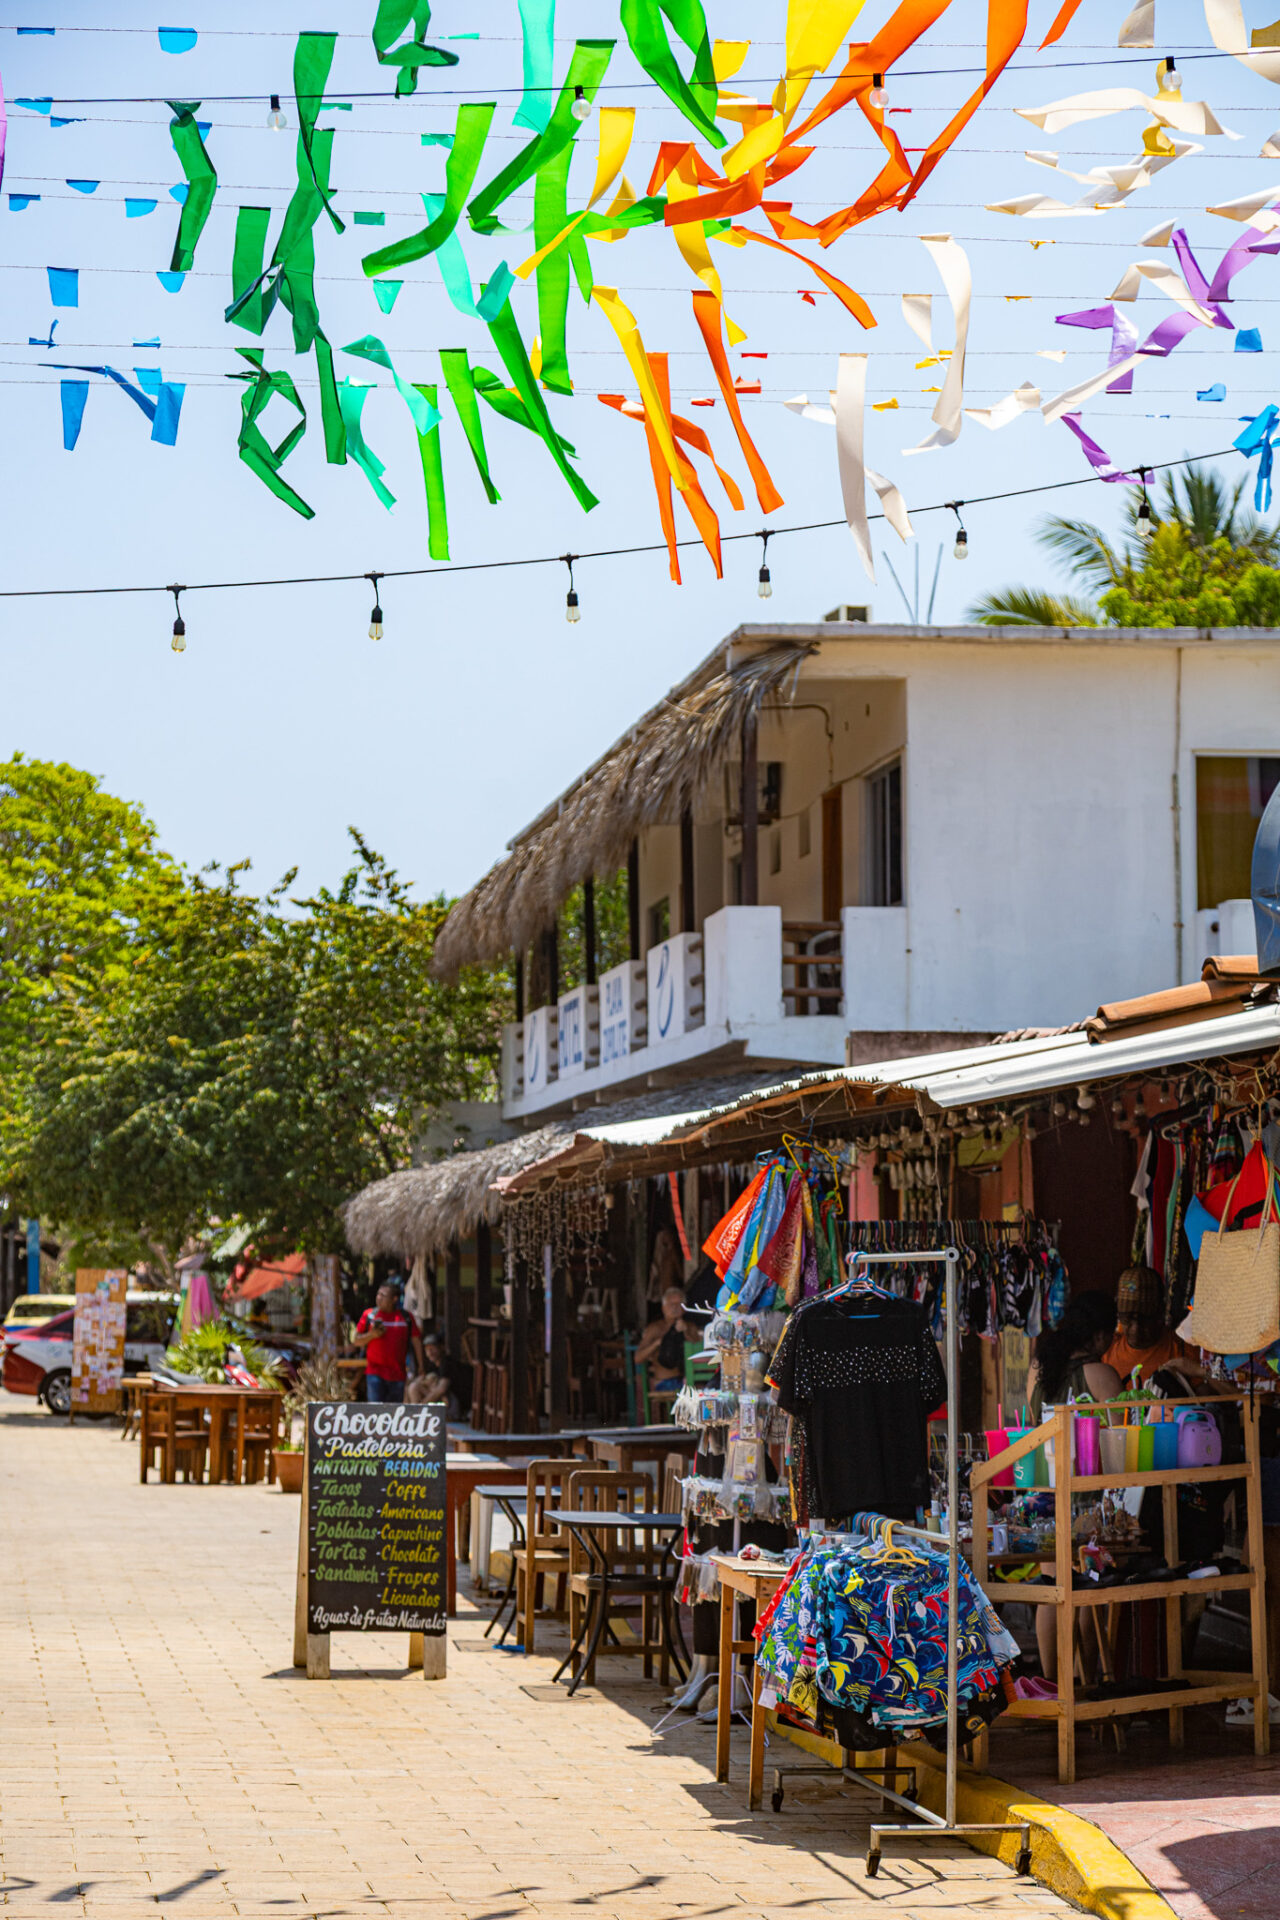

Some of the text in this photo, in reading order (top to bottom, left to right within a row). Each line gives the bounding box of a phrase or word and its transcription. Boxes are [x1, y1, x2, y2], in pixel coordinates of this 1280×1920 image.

[314, 1404, 440, 1437] Chocolate
[325, 1437, 427, 1458] Pasteleria
[386, 1480, 427, 1501] Coffe
[387, 1566, 440, 1589] Frapes
[381, 1587, 441, 1607] Licuados
[350, 1605, 363, 1626] de
[361, 1608, 398, 1630] frutas
